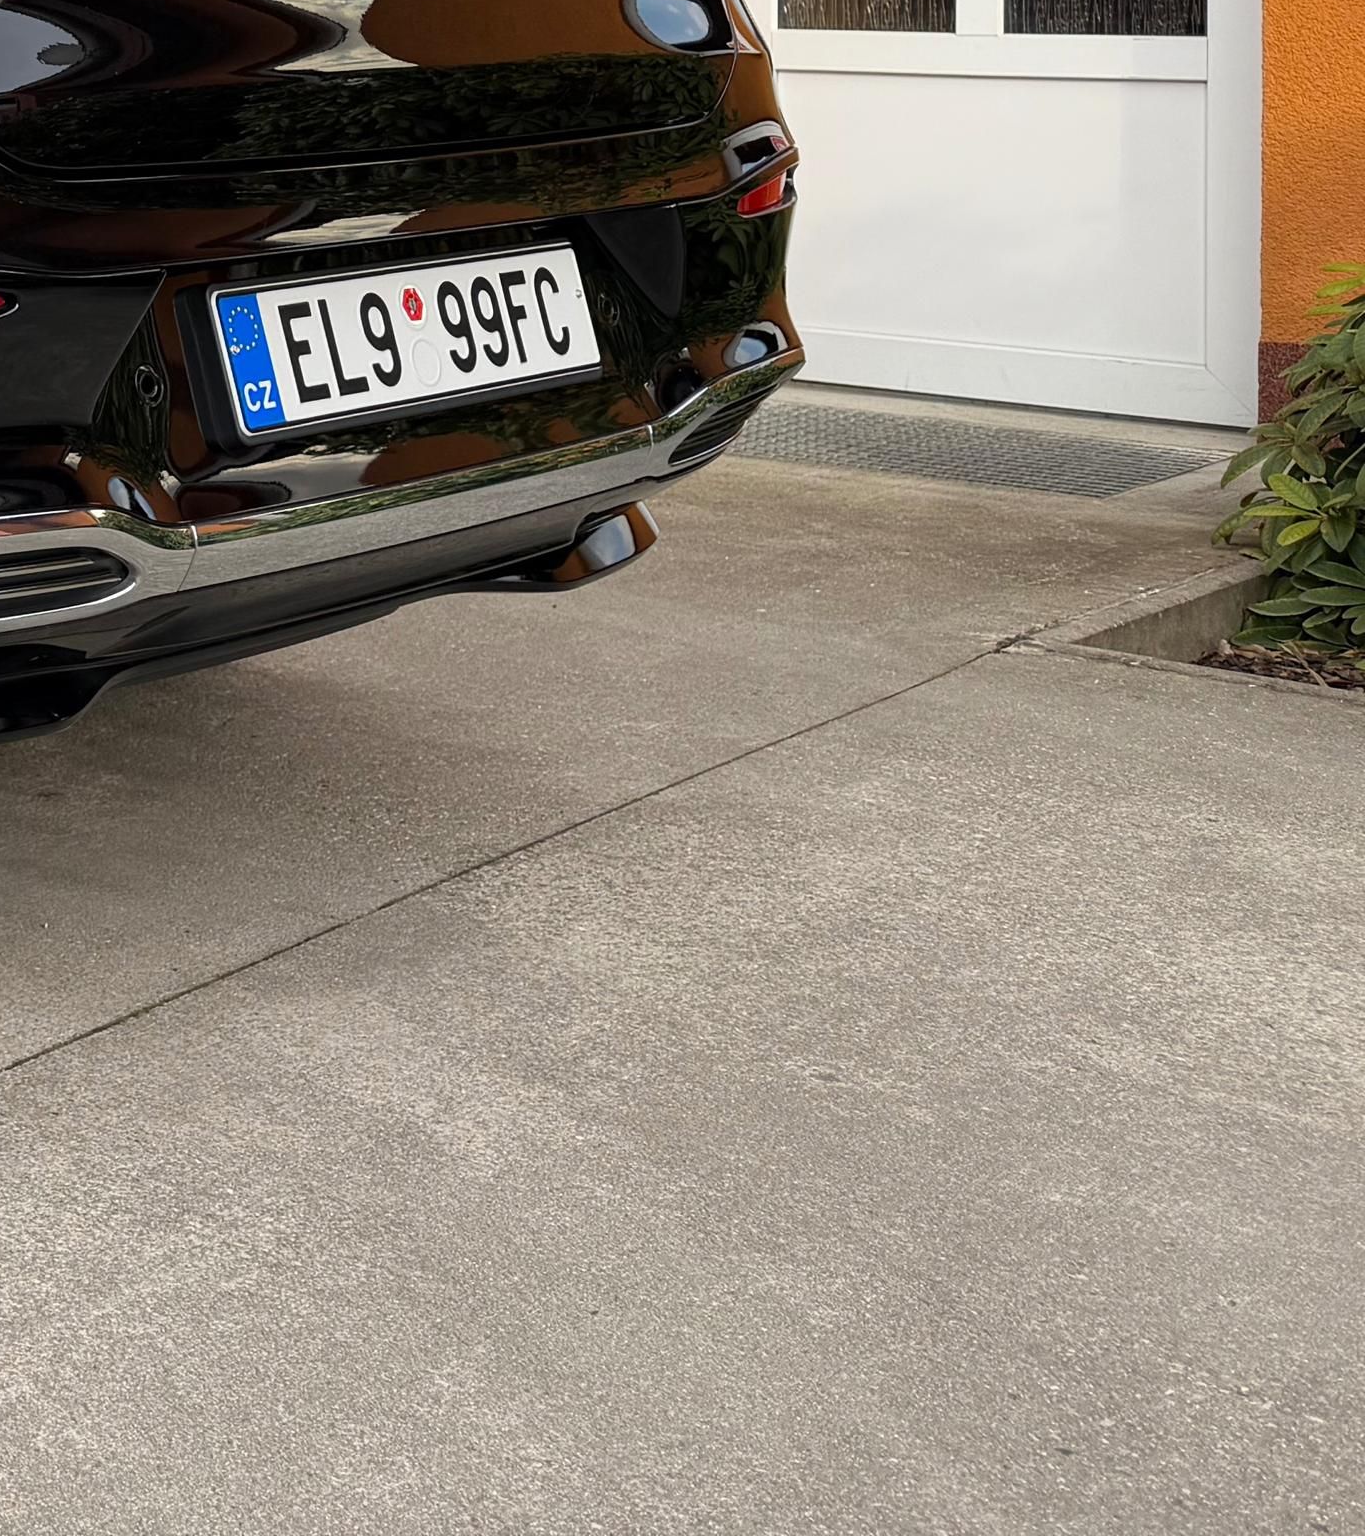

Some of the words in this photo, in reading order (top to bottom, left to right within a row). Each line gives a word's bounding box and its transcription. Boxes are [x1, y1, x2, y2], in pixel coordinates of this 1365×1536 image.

[277, 292, 403, 403] EL9
[436, 267, 571, 373] 99FC
[243, 380, 276, 412] CZ
